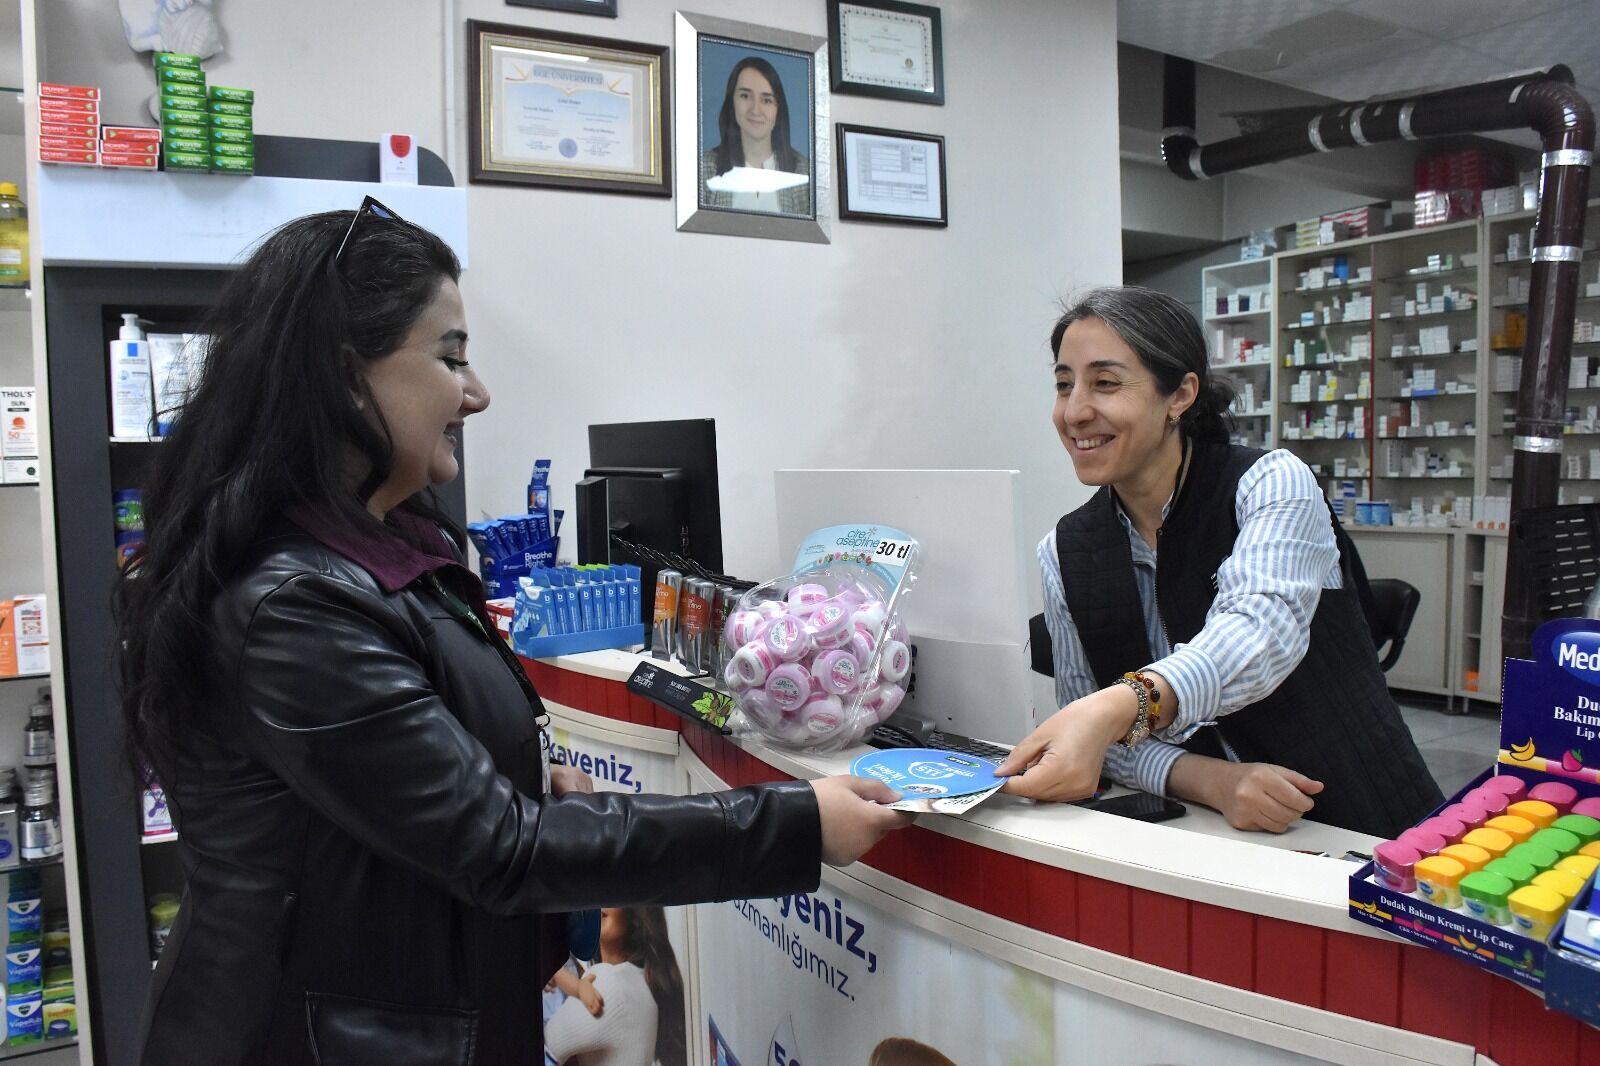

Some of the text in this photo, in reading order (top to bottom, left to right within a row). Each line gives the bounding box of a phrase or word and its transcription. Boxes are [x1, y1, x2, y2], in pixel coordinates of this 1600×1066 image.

[524, 551, 552, 561] Breathe
[876, 541, 911, 559] 30 tl
[1577, 695, 1600, 710] Du
[1576, 726, 1595, 741] Lip
[1380, 895, 1515, 951] Dudak Bakım Kremi Lip Care
